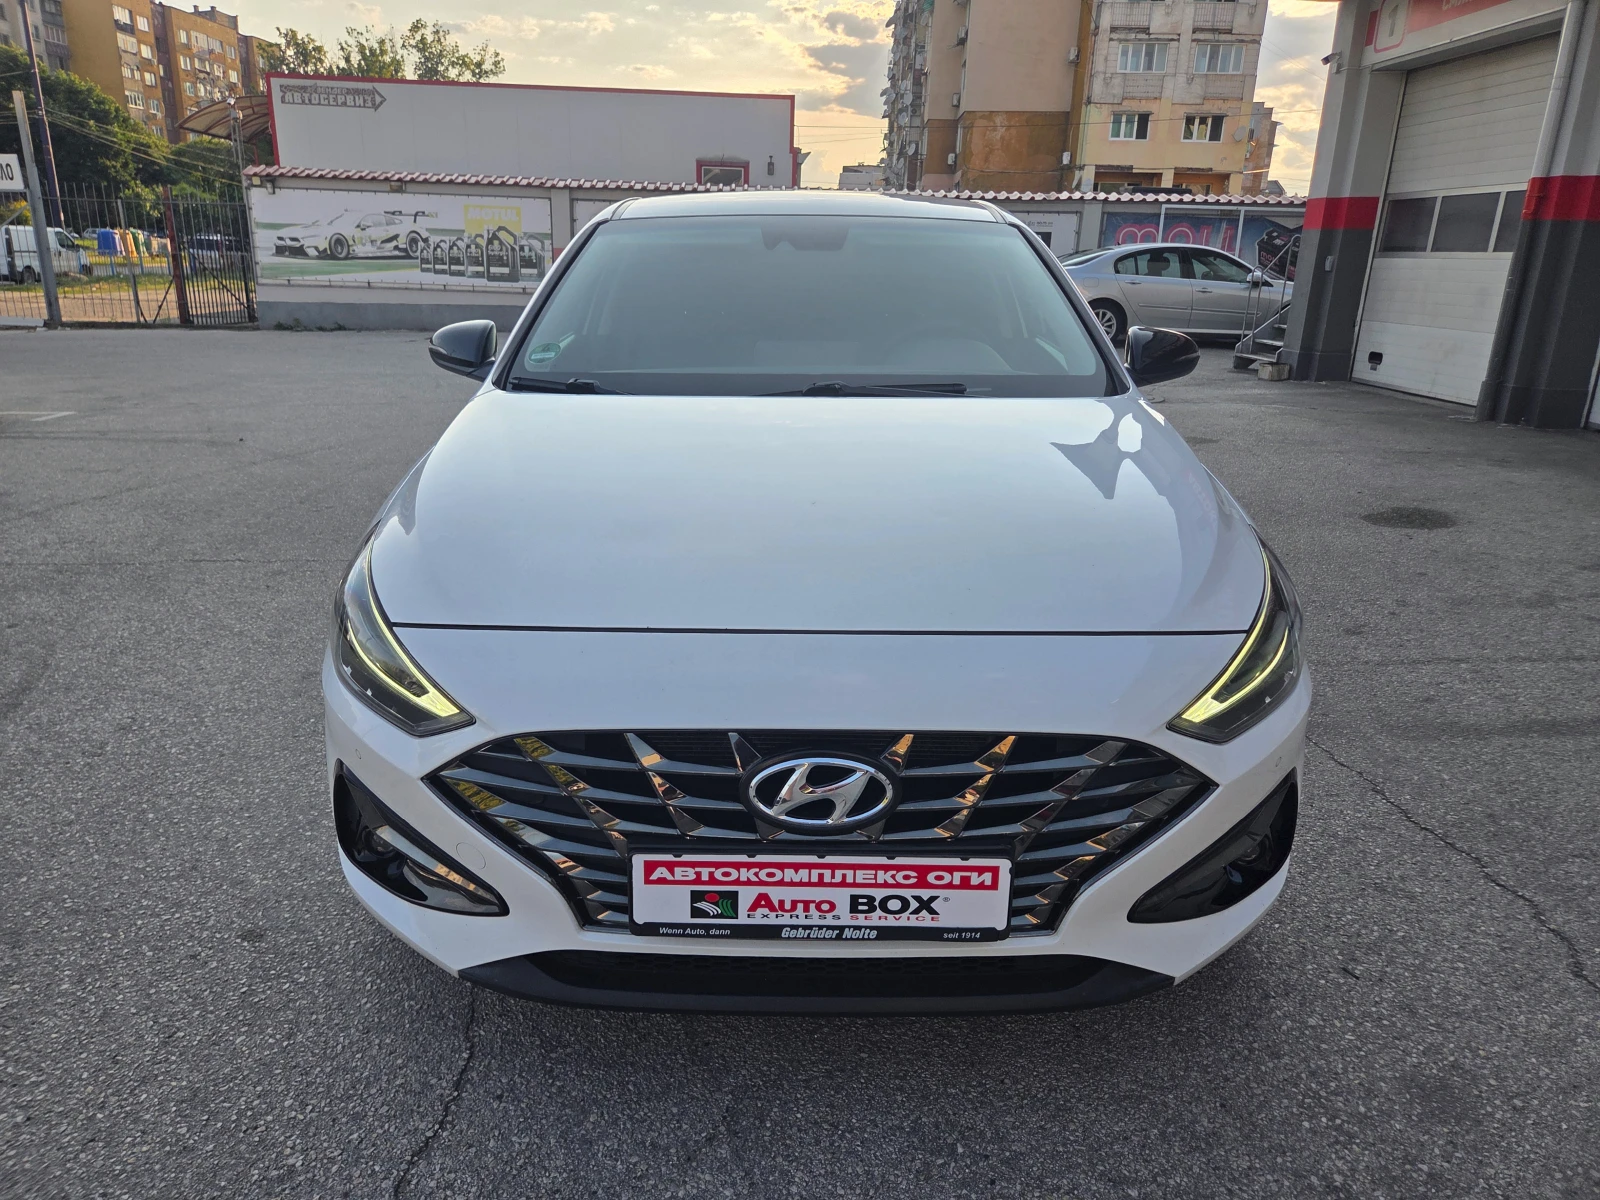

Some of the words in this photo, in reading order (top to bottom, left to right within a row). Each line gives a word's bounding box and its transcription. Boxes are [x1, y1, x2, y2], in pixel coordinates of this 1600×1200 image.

[1388, 4, 1400, 37] 1
[284, 92, 372, 107] АВТОСЕРВИЗ
[467, 207, 519, 220] MOTUL
[648, 866, 919, 885] АВТОКОМПЛЕКС
[927, 870, 994, 886] ОГИ
[848, 894, 941, 916] BOX
[850, 914, 940, 922] SERVICE
[659, 927, 683, 935] Wenn
[685, 927, 707, 936] Auto,
[708, 928, 731, 936] dann
[781, 927, 840, 939] Gebrüder
[842, 928, 878, 940] Nolte
[943, 931, 959, 939] seit
[961, 931, 981, 939] 1914
